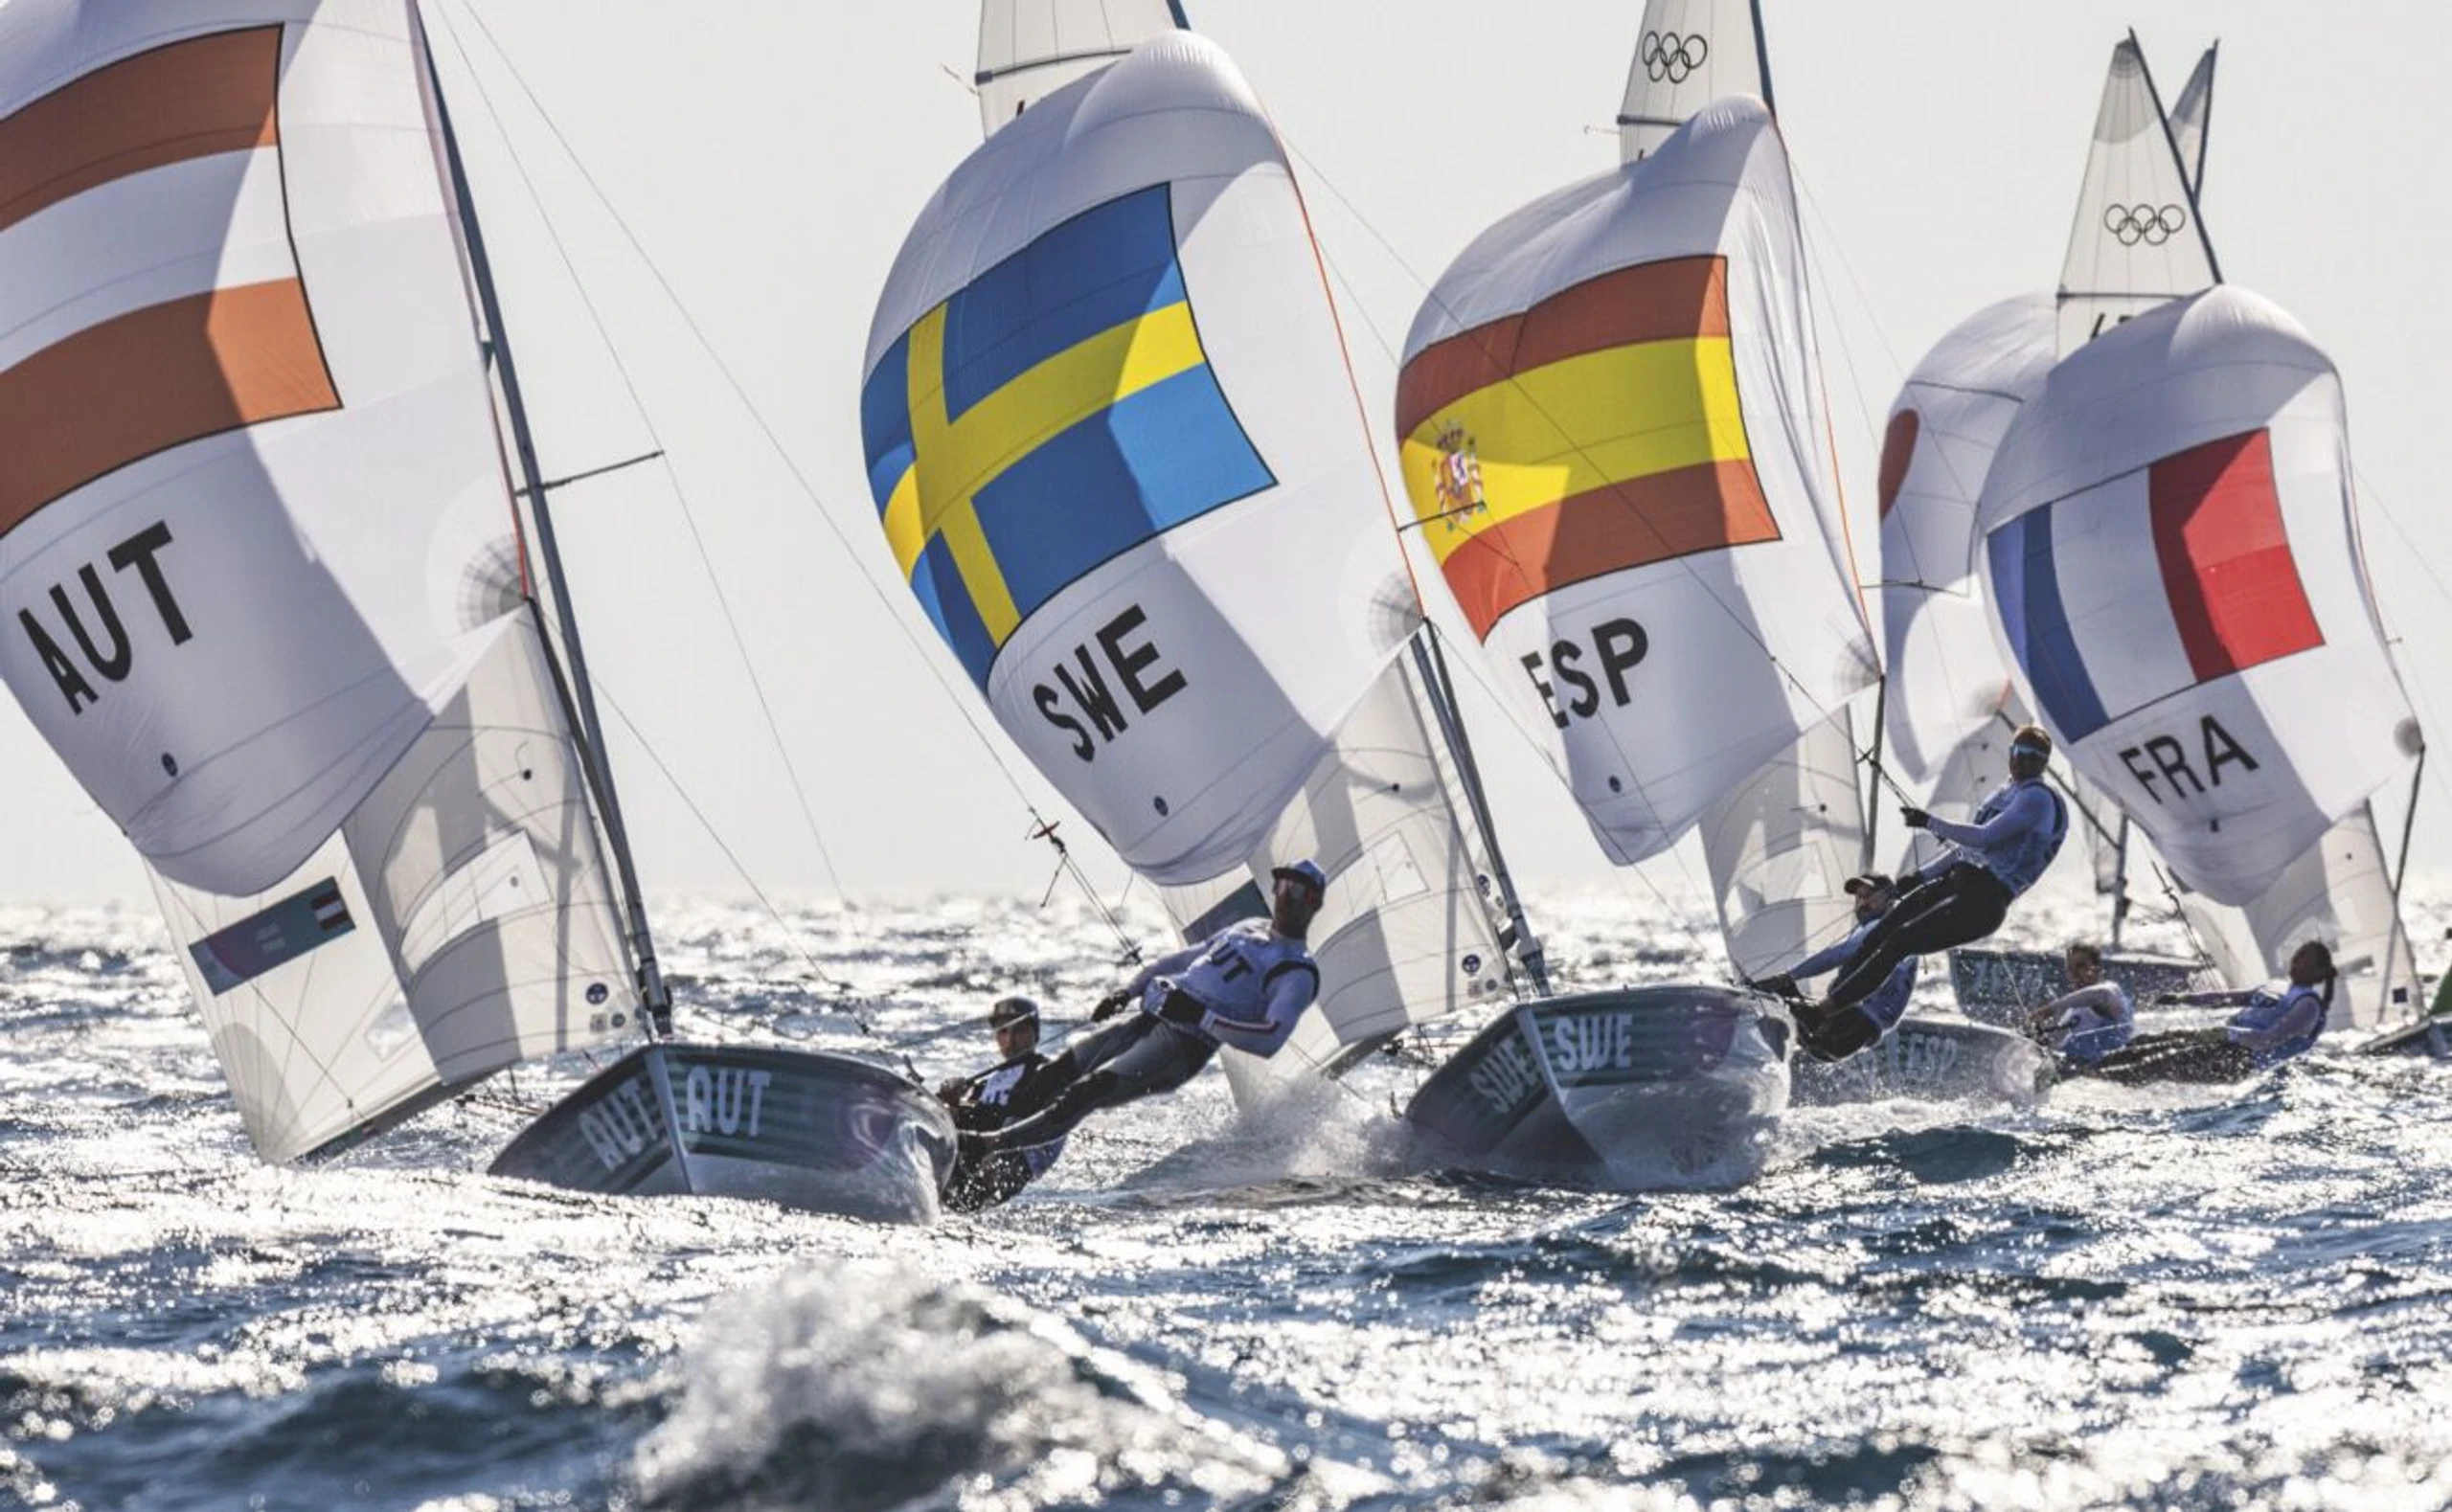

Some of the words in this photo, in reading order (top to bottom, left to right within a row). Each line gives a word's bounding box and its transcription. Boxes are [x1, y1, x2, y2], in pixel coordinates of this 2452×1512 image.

[17, 520, 193, 716] AUT
[1033, 603, 1188, 763] SWE
[1520, 618, 1648, 730] ESP
[2118, 714, 2260, 805] FRA
[1469, 1036, 1537, 1115] SWE
[1555, 1013, 1633, 1072] SWE
[579, 1077, 659, 1172] AUT
[686, 1065, 773, 1137] AUT
